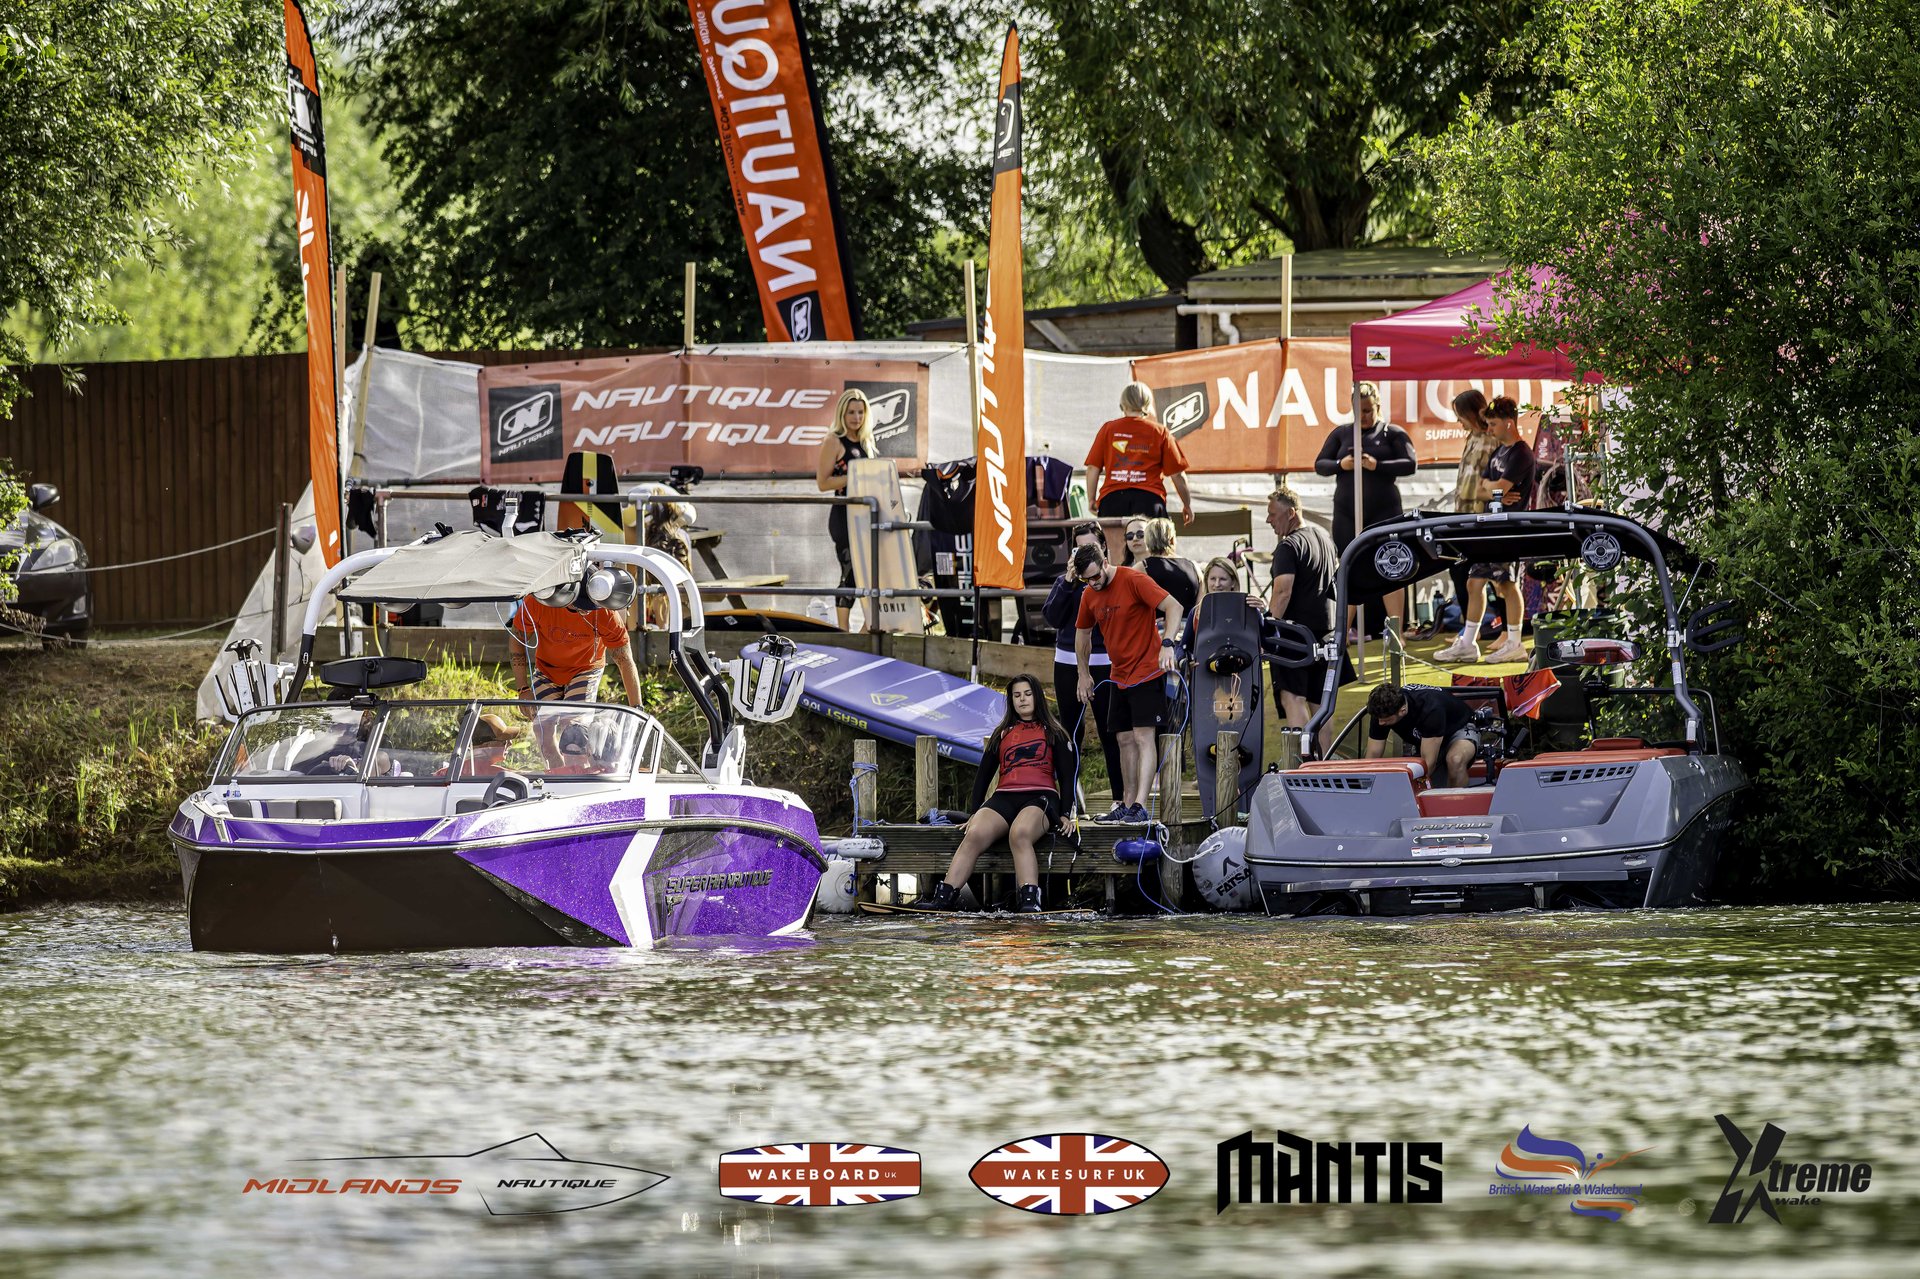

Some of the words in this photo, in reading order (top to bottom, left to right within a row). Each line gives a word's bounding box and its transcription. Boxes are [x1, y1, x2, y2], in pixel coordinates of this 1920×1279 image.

[571, 384, 831, 411] NAUTIQUE
[498, 426, 554, 456] NAUTIQUE
[573, 421, 829, 447] NAUTIQUE
[875, 425, 909, 442] TIQUE
[827, 708, 868, 730] BEAST
[1411, 822, 1494, 832] NAUTIQUE
[666, 875, 706, 893] SUPER
[726, 869, 772, 888] NAUTIQUE
[1216, 868, 1252, 896] FATSA
